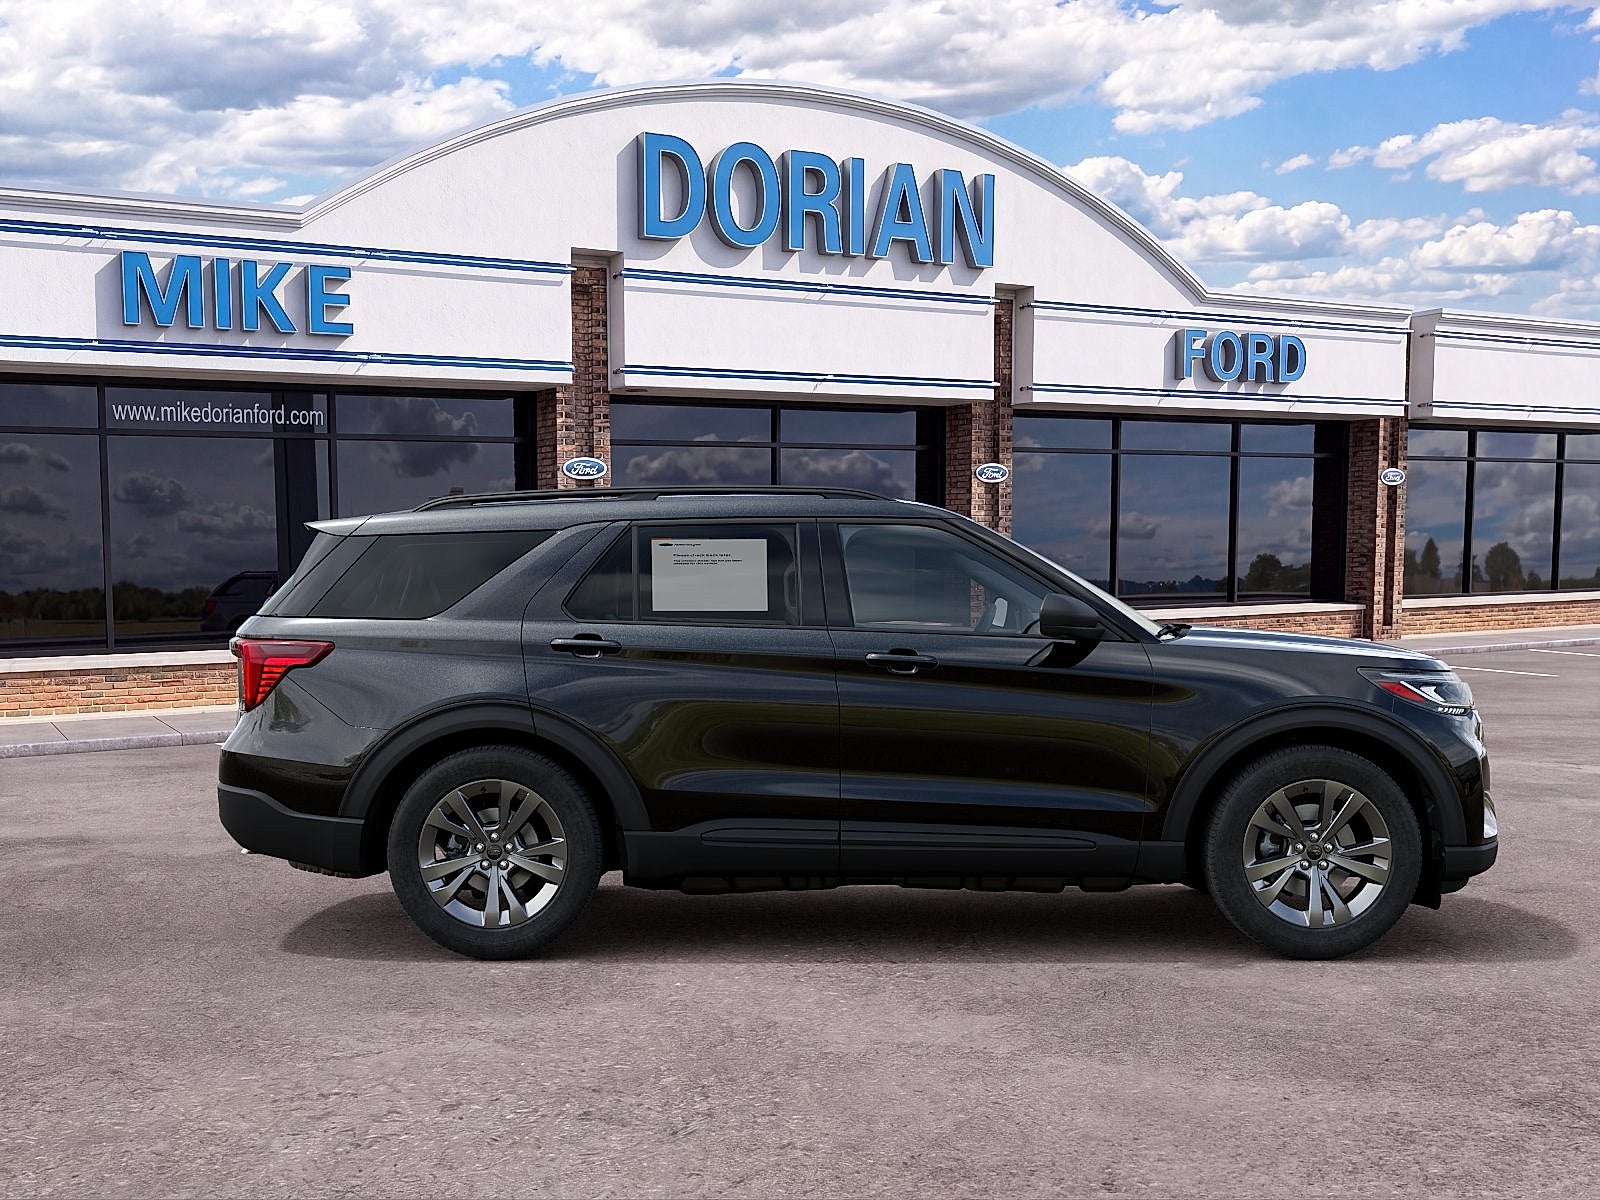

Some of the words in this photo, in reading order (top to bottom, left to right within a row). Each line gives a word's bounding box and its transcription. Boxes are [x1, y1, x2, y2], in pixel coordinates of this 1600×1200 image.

[638, 131, 995, 269] DORIAN
[120, 250, 354, 336] MIKE
[1176, 328, 1307, 384] FORD
[112, 401, 325, 426] www.mikedorianford.com
[571, 462, 599, 475] Ford
[981, 467, 1003, 479] Ford
